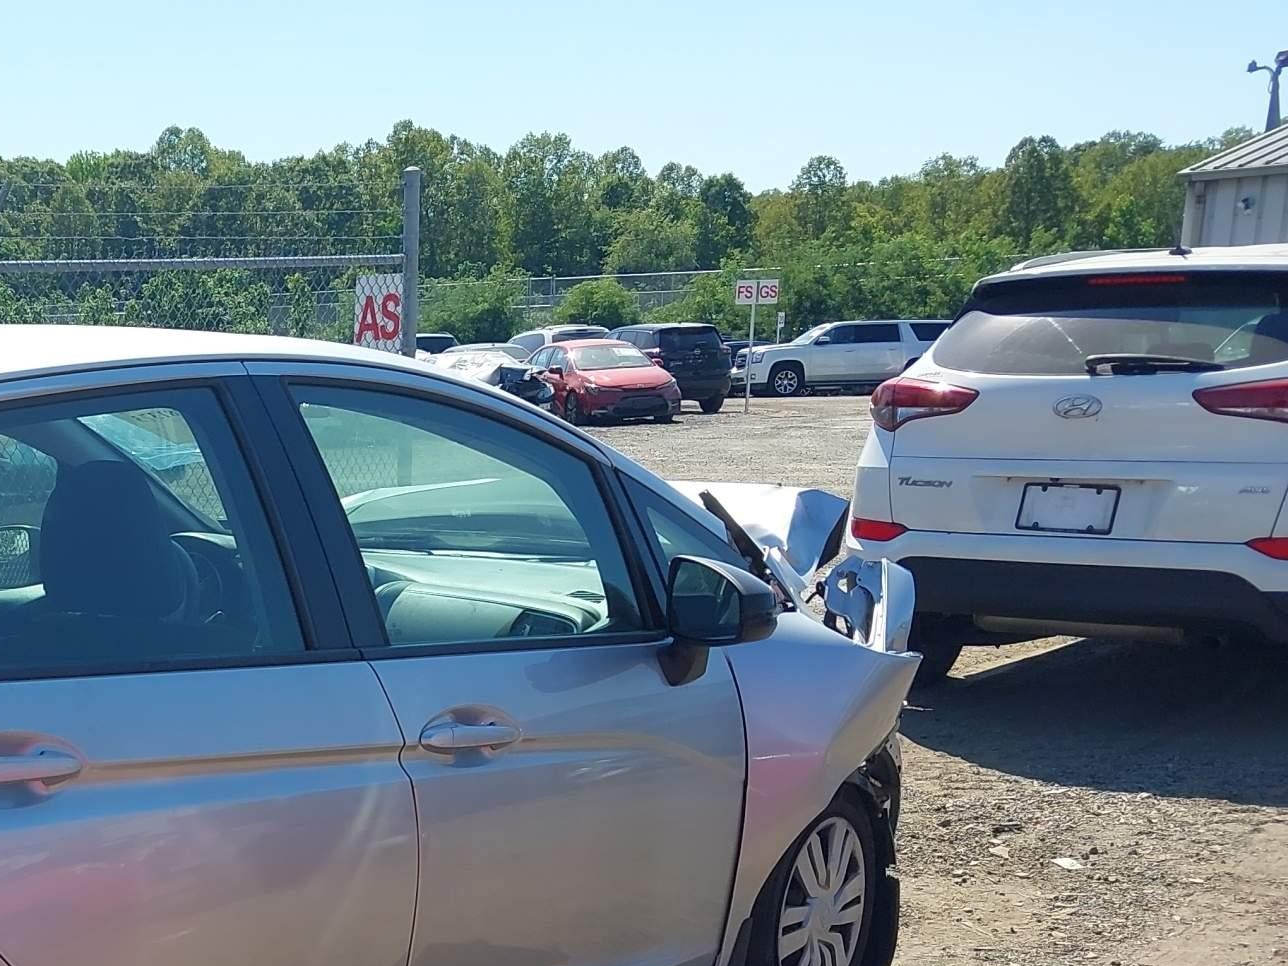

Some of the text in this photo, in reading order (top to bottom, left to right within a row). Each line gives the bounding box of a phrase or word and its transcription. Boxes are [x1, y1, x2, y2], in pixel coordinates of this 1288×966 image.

[737, 285, 778, 299] FS GS
[356, 293, 400, 342] AS
